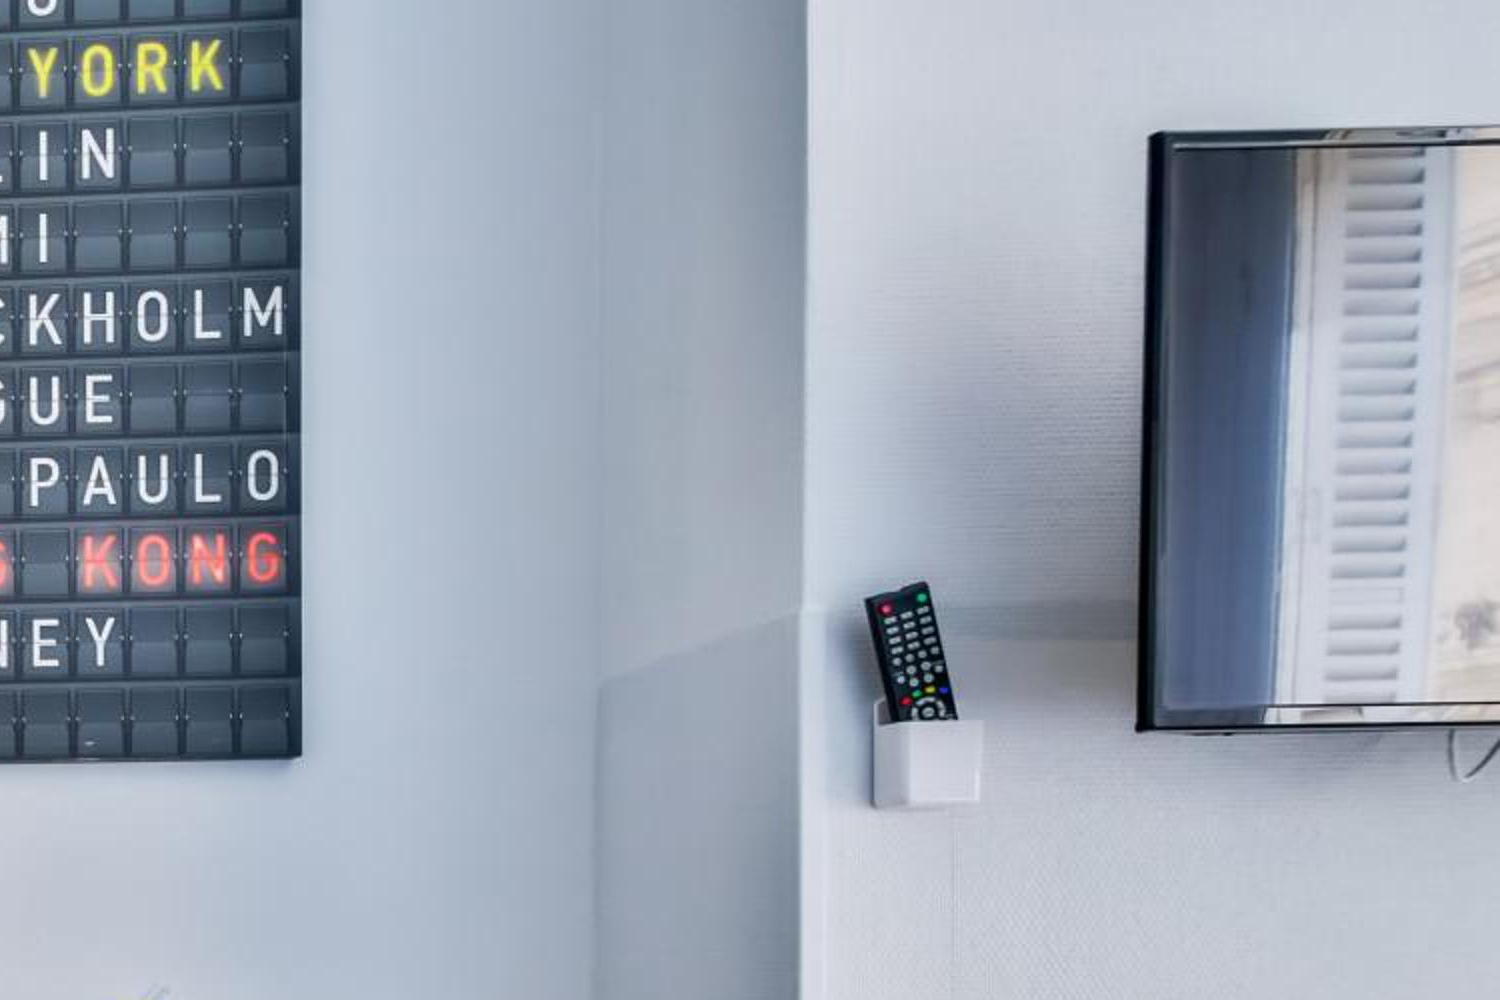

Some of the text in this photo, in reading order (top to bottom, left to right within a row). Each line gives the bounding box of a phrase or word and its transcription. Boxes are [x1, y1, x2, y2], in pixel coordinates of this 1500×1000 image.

[28, 39, 223, 98] YORK
[30, 450, 279, 507] PAULO
[82, 532, 280, 588] KONG
